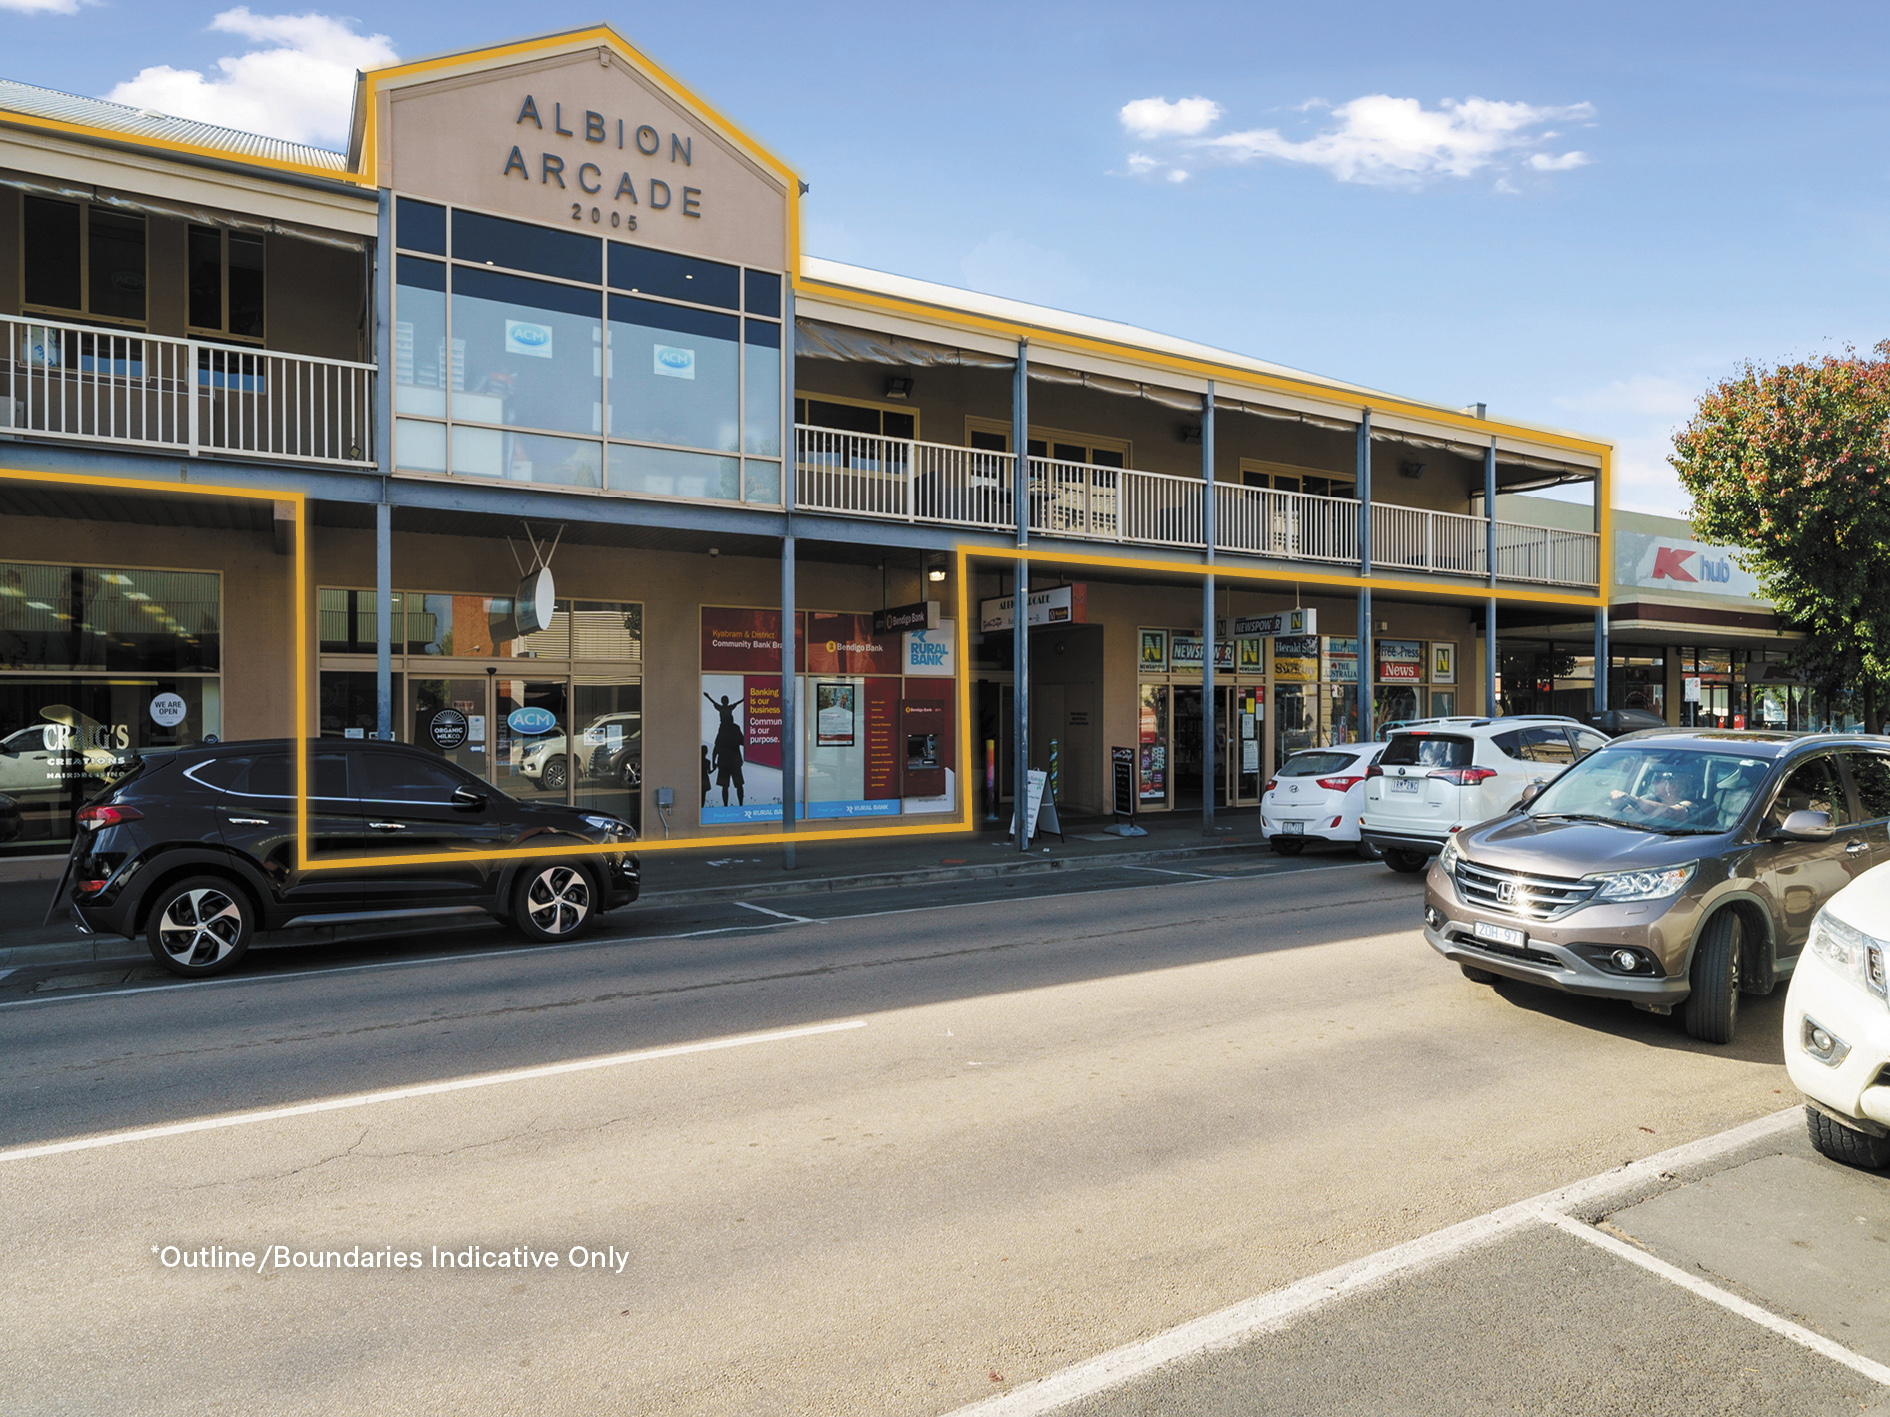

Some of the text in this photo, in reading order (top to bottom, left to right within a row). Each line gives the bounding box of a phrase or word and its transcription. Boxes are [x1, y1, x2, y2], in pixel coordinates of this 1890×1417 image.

[516, 94, 691, 166] ALBION
[503, 145, 701, 218] ARCADE
[571, 203, 637, 231] 2005
[513, 328, 545, 342] ACM
[661, 352, 688, 364] ACM
[1652, 546, 1729, 583] K hub
[893, 615, 911, 626] Bendigo
[911, 612, 924, 622] Bank
[1236, 617, 1280, 633] NEWSPOWR
[712, 629, 775, 639] Kyabram & District
[712, 639, 751, 649] Community
[753, 640, 770, 649] Bank
[837, 643, 883, 652] Bendigo Bank
[911, 642, 948, 655] RURAL
[1275, 641, 1301, 652] Herald
[1400, 646, 1419, 658] Press
[911, 654, 944, 665] BANK
[1385, 662, 1415, 676] News
[750, 687, 779, 697] Banking
[750, 697, 756, 705] is
[750, 706, 780, 714] business
[512, 713, 550, 726] ACM
[750, 717, 782, 726] Commun
[43, 724, 130, 750] CRAIG'S
[750, 736, 780, 744] purpose.
[46, 756, 126, 766] CREATIONS
